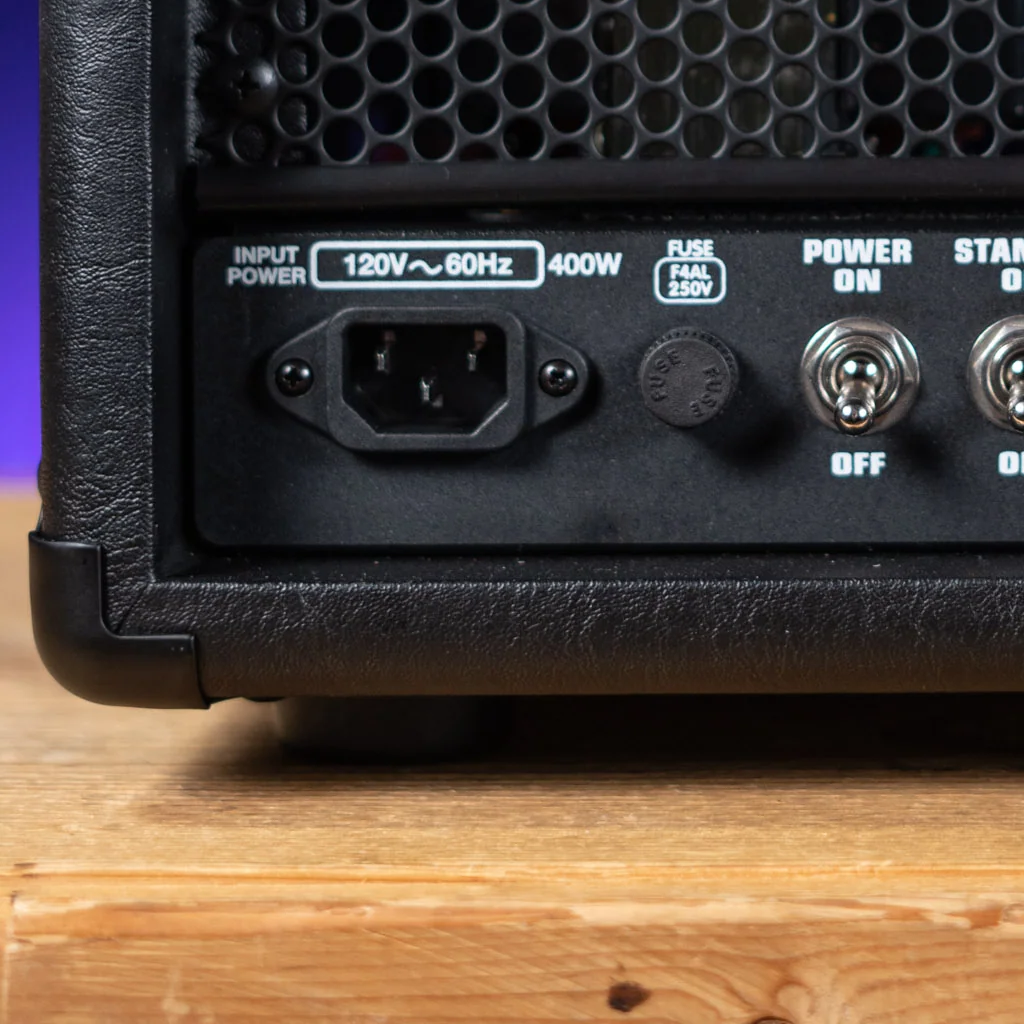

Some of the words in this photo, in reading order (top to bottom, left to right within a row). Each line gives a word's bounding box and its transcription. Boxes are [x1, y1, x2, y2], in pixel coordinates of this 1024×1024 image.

[233, 246, 300, 265] INPUT
[667, 240, 714, 257] FUSE
[803, 238, 912, 264] POWER
[547, 252, 623, 276] 400W
[227, 267, 307, 286] POWER
[833, 268, 881, 293] ON
[668, 281, 713, 297] 250V
[831, 452, 886, 476] OFF
